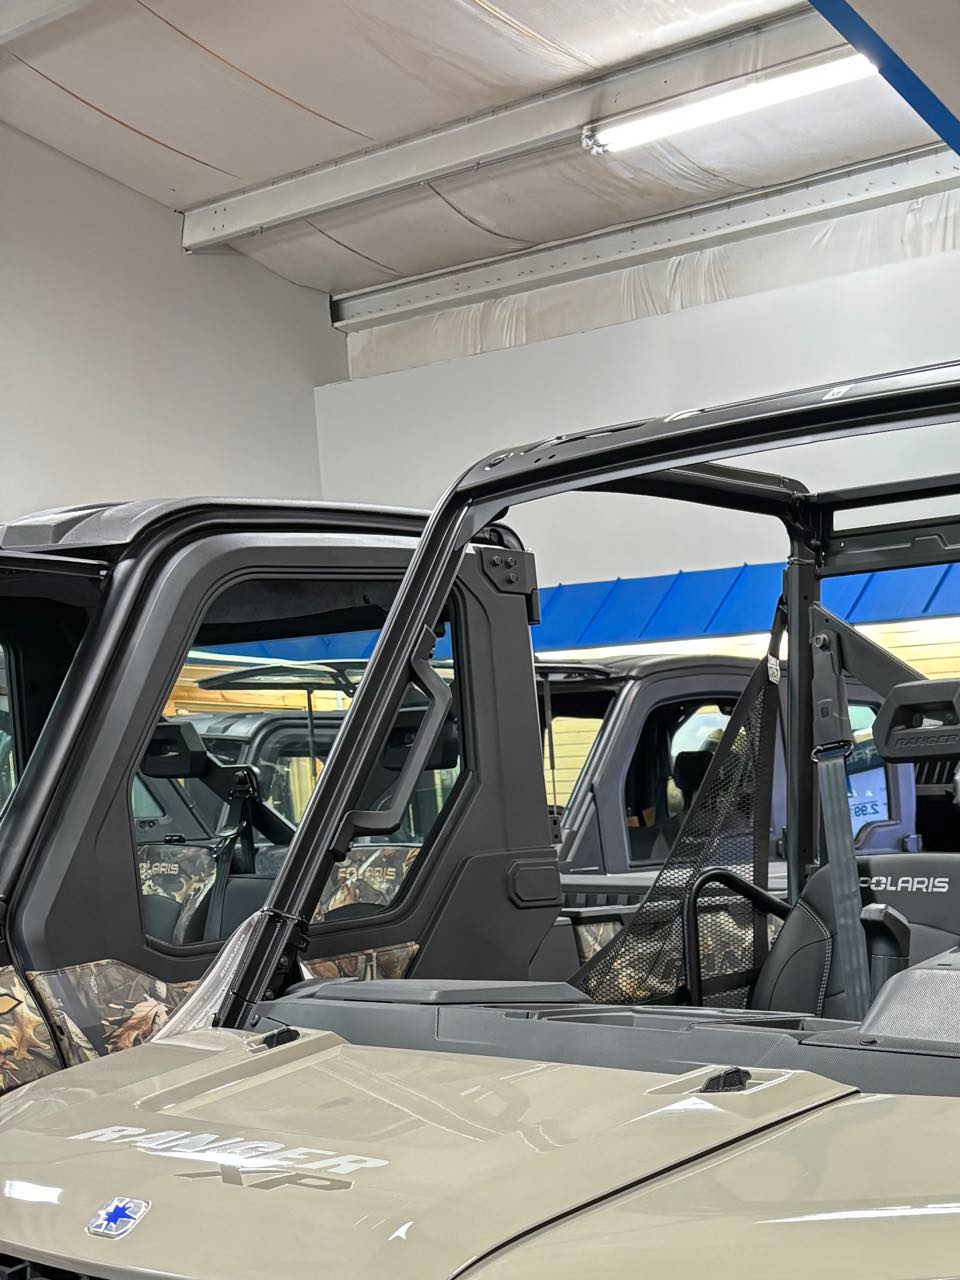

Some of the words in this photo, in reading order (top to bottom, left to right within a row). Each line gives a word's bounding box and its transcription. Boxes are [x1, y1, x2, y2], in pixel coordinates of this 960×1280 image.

[860, 876, 950, 893] POLARIS
[66, 1125, 390, 1174] RANGER
[173, 1167, 355, 1191] XP
